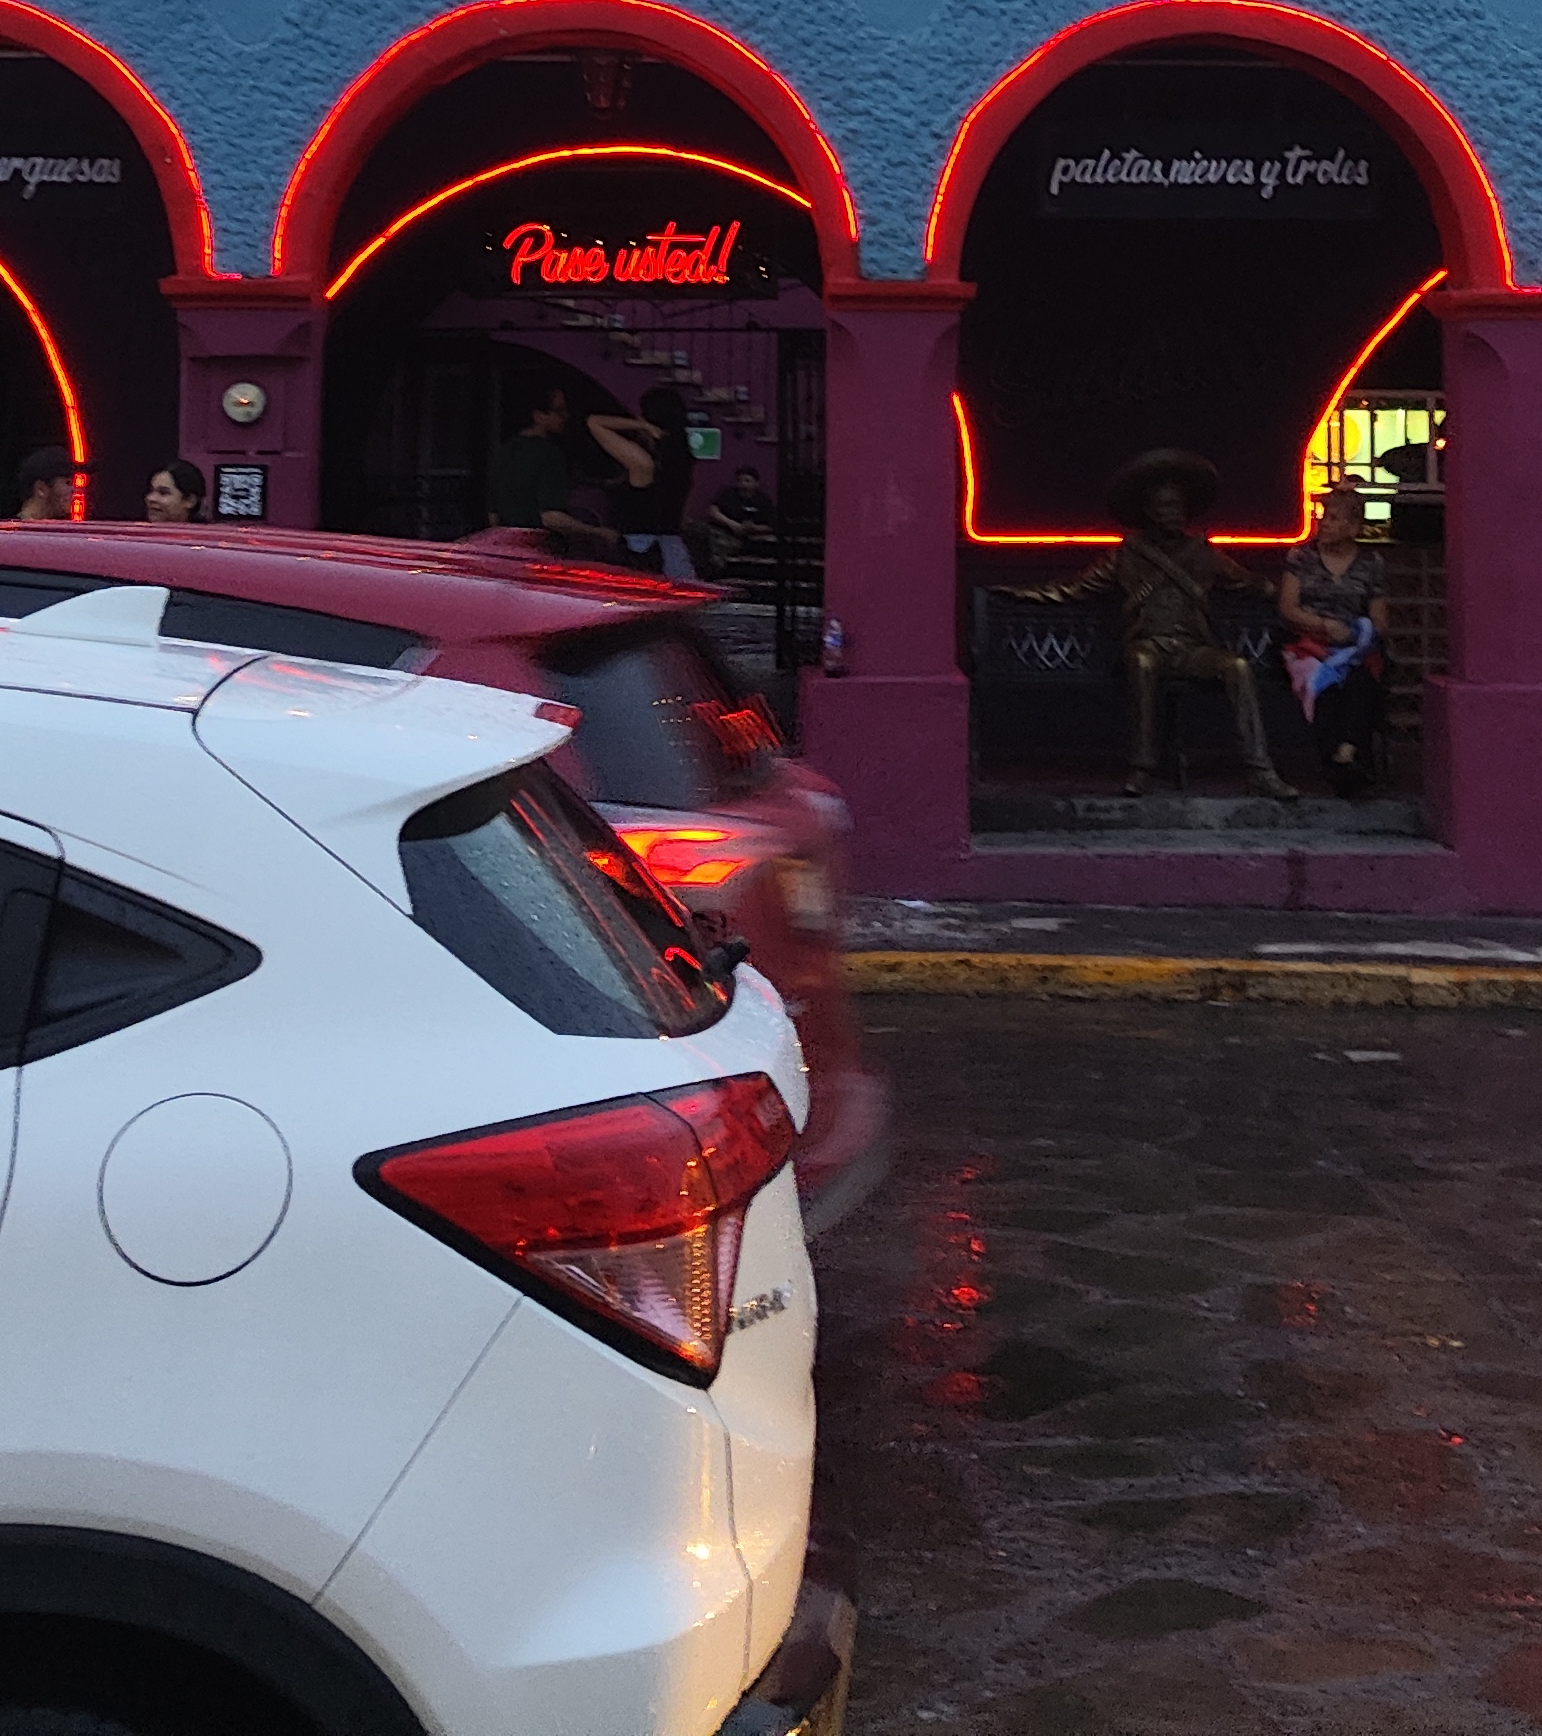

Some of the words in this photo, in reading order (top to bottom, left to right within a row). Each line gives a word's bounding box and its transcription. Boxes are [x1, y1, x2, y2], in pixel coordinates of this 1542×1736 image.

[1258, 159, 1282, 200] y
[502, 221, 610, 285] Pase
[612, 219, 742, 285] usted!
